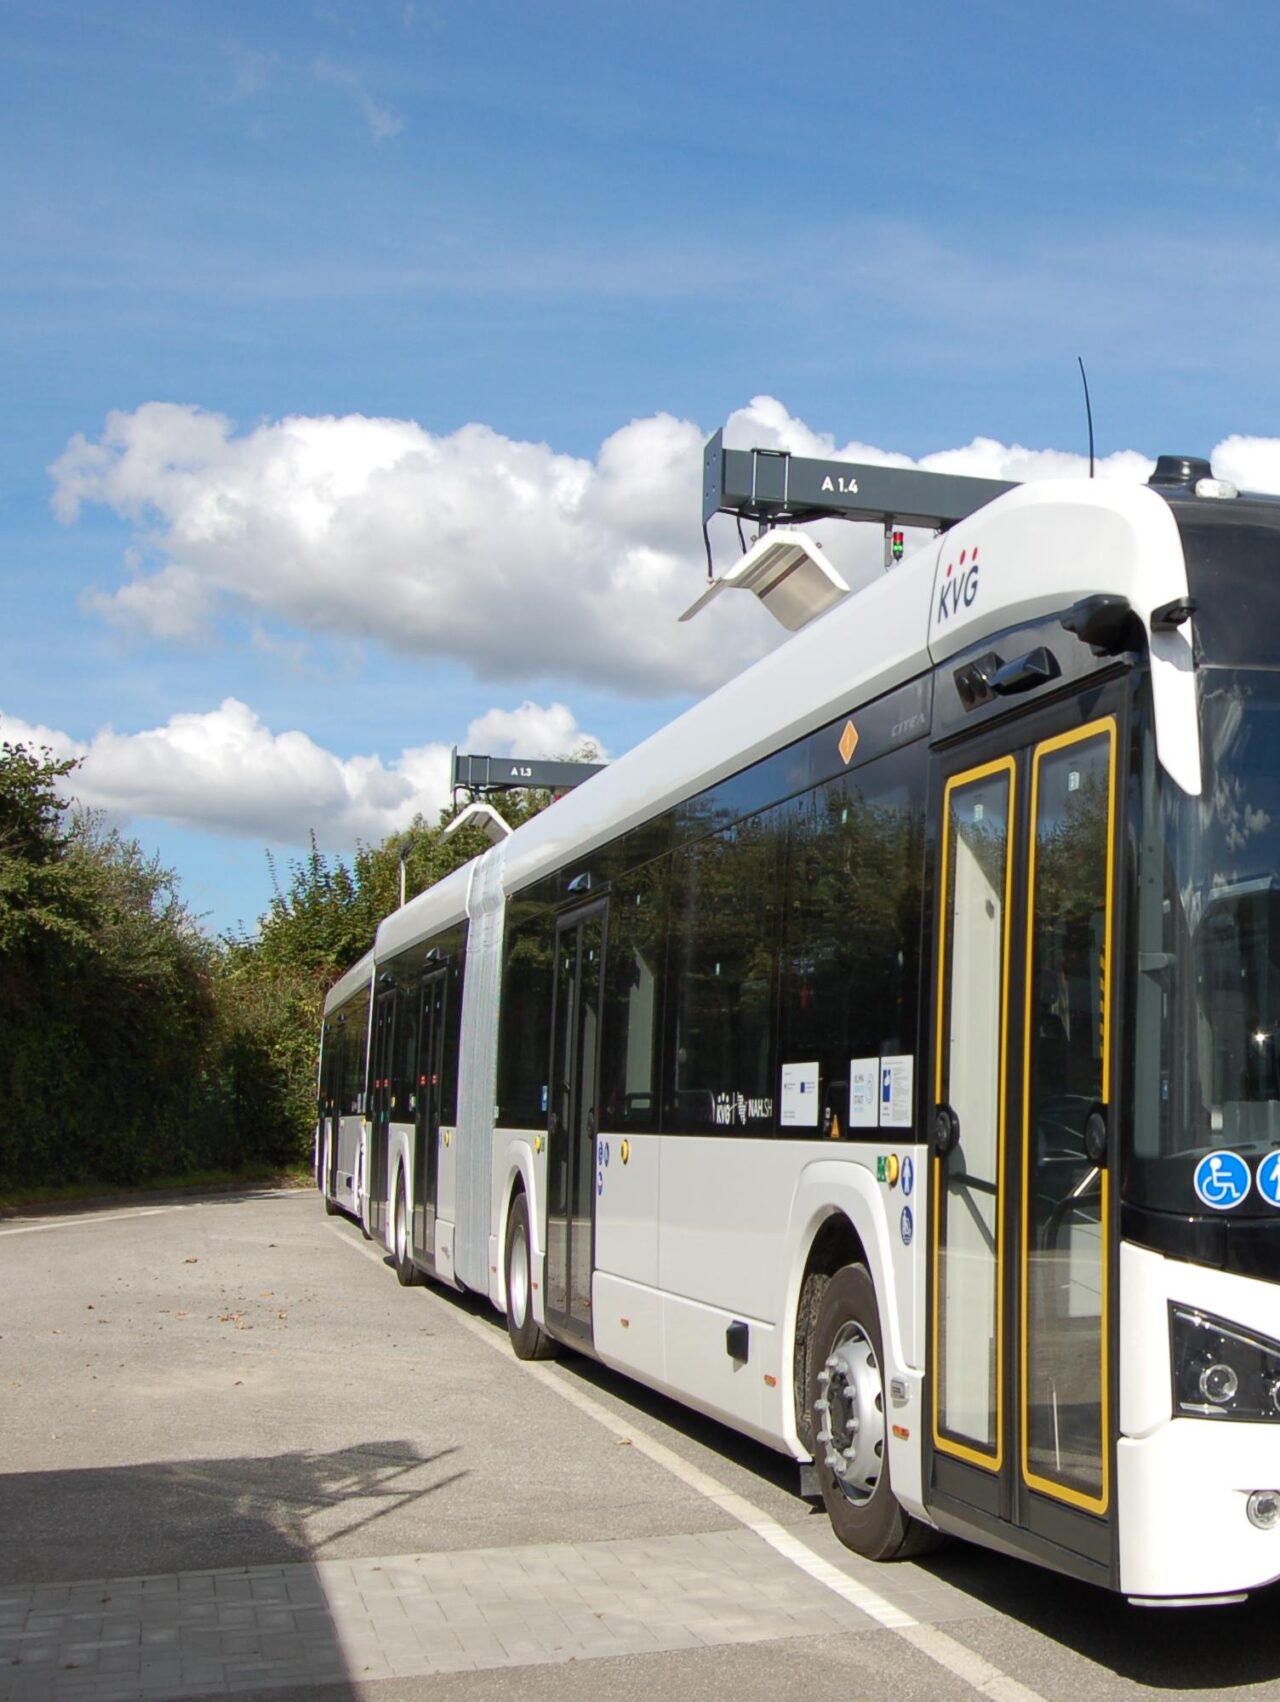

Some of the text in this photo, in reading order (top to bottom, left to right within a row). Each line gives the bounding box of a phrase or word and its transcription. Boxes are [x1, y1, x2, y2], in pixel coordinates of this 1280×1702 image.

[821, 476, 859, 494] A 1.4
[937, 564, 979, 624] KVG
[510, 767, 532, 778] A 1.3
